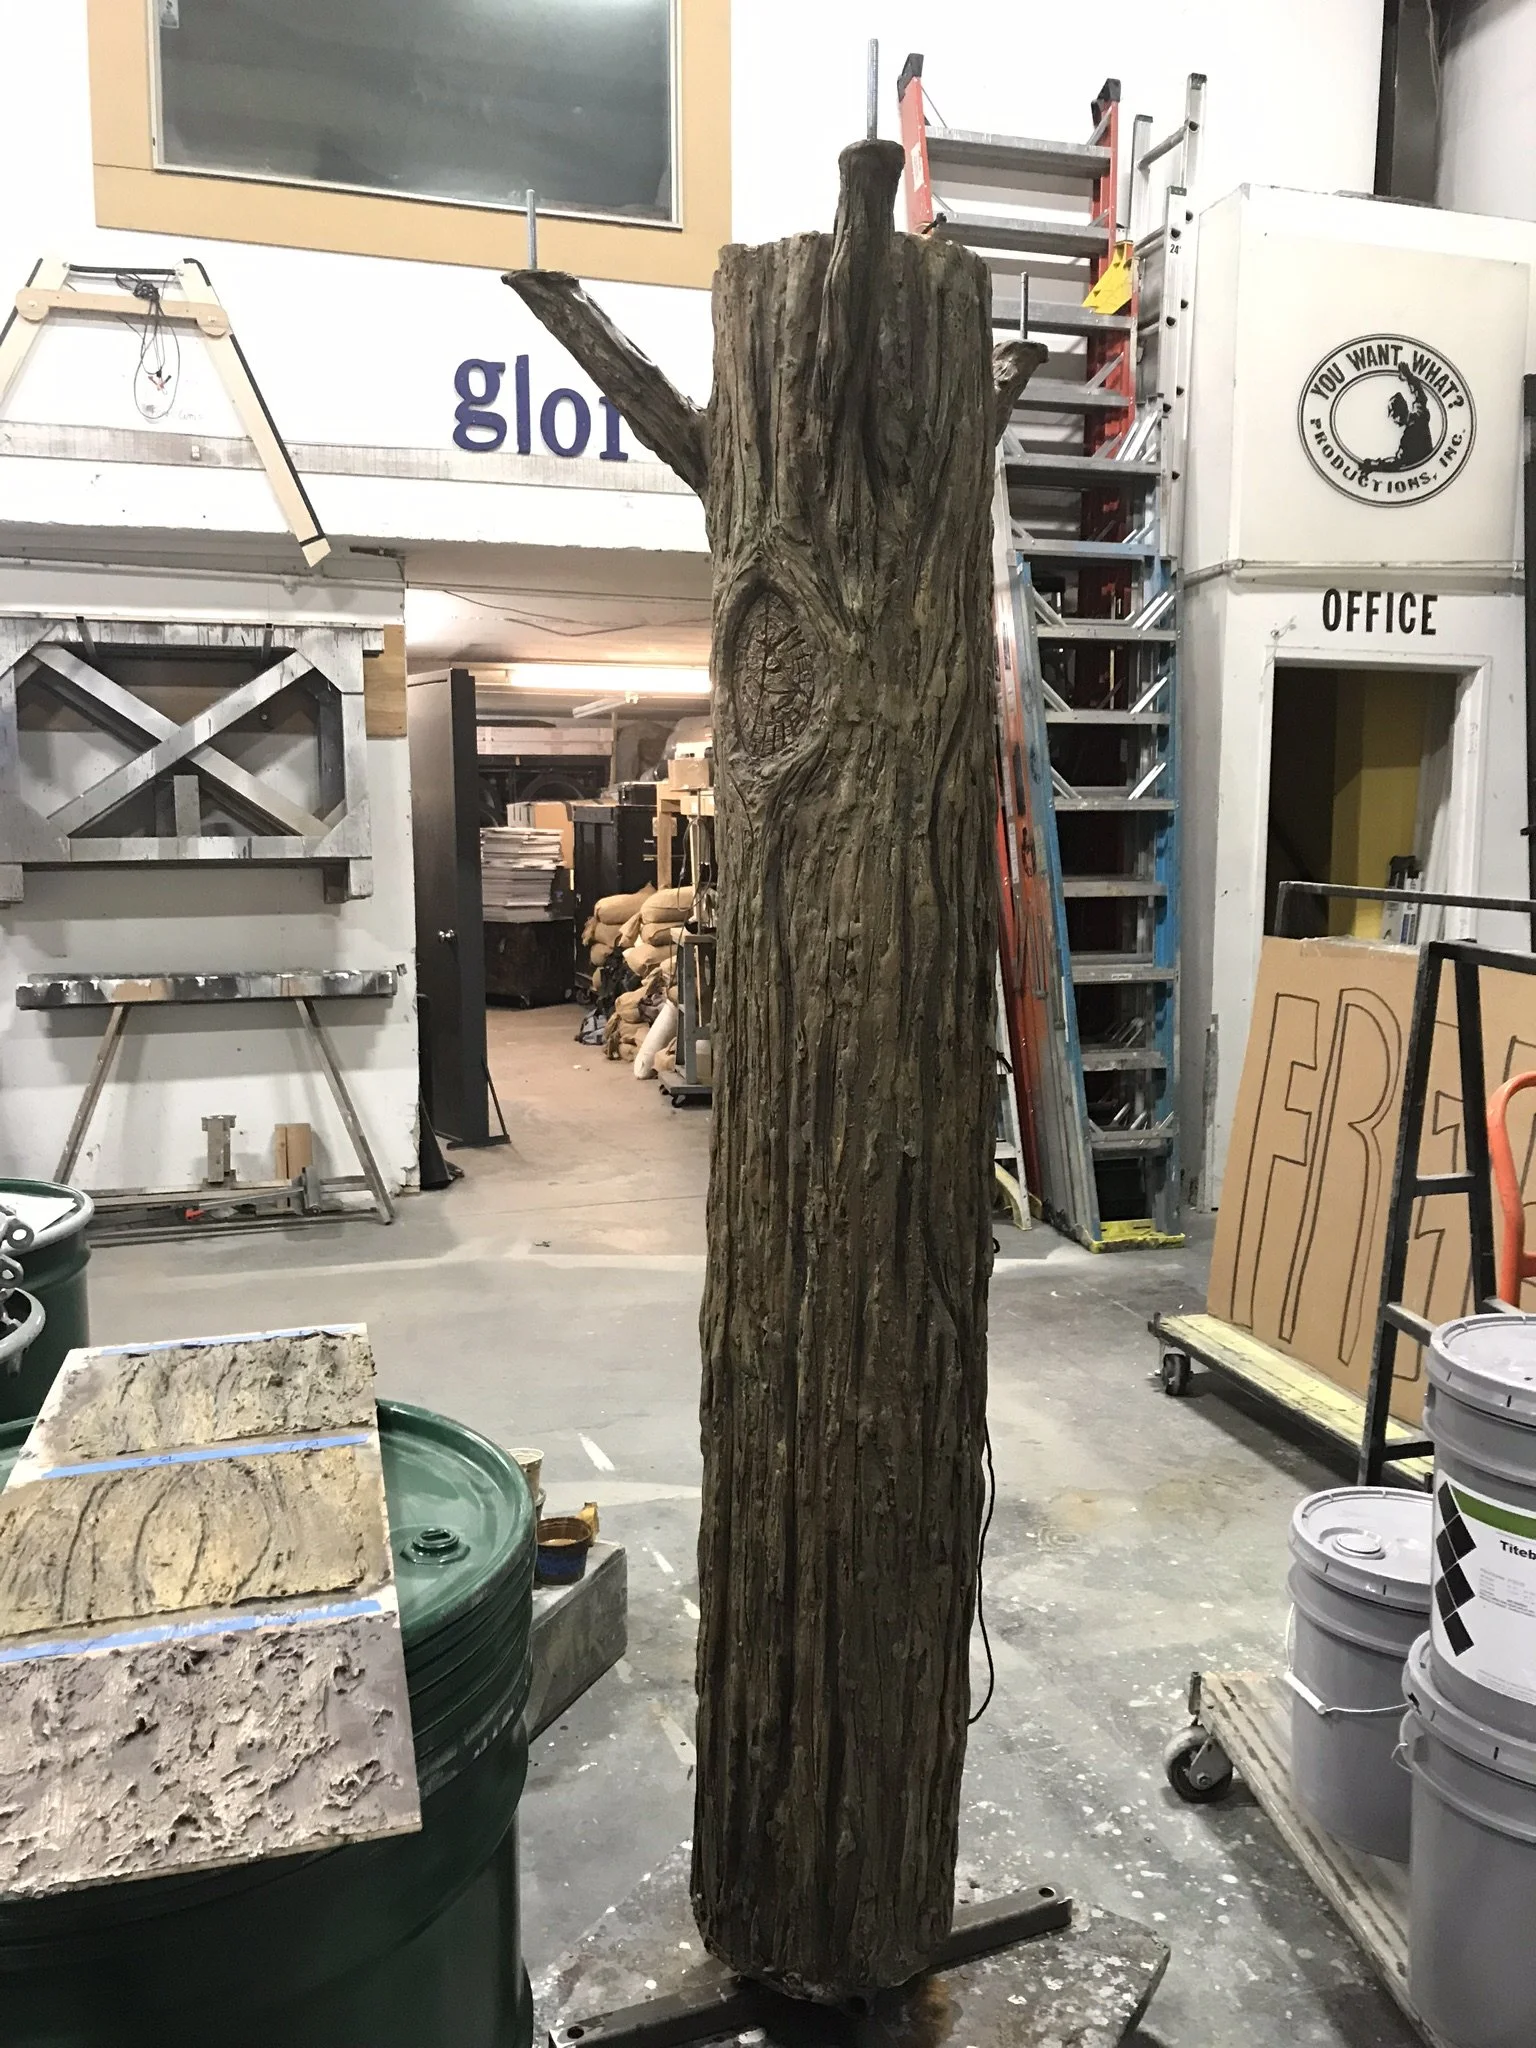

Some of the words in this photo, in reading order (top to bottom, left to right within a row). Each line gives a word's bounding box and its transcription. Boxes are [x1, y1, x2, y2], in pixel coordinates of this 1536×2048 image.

[1310, 362, 1346, 401] YOU
[1345, 343, 1404, 372] WANT
[1412, 350, 1465, 409] WHAT?
[1309, 417, 1438, 494] PRODUCTIONS,
[1438, 428, 1467, 468] INC.
[1322, 588, 1438, 636] OFFICE
